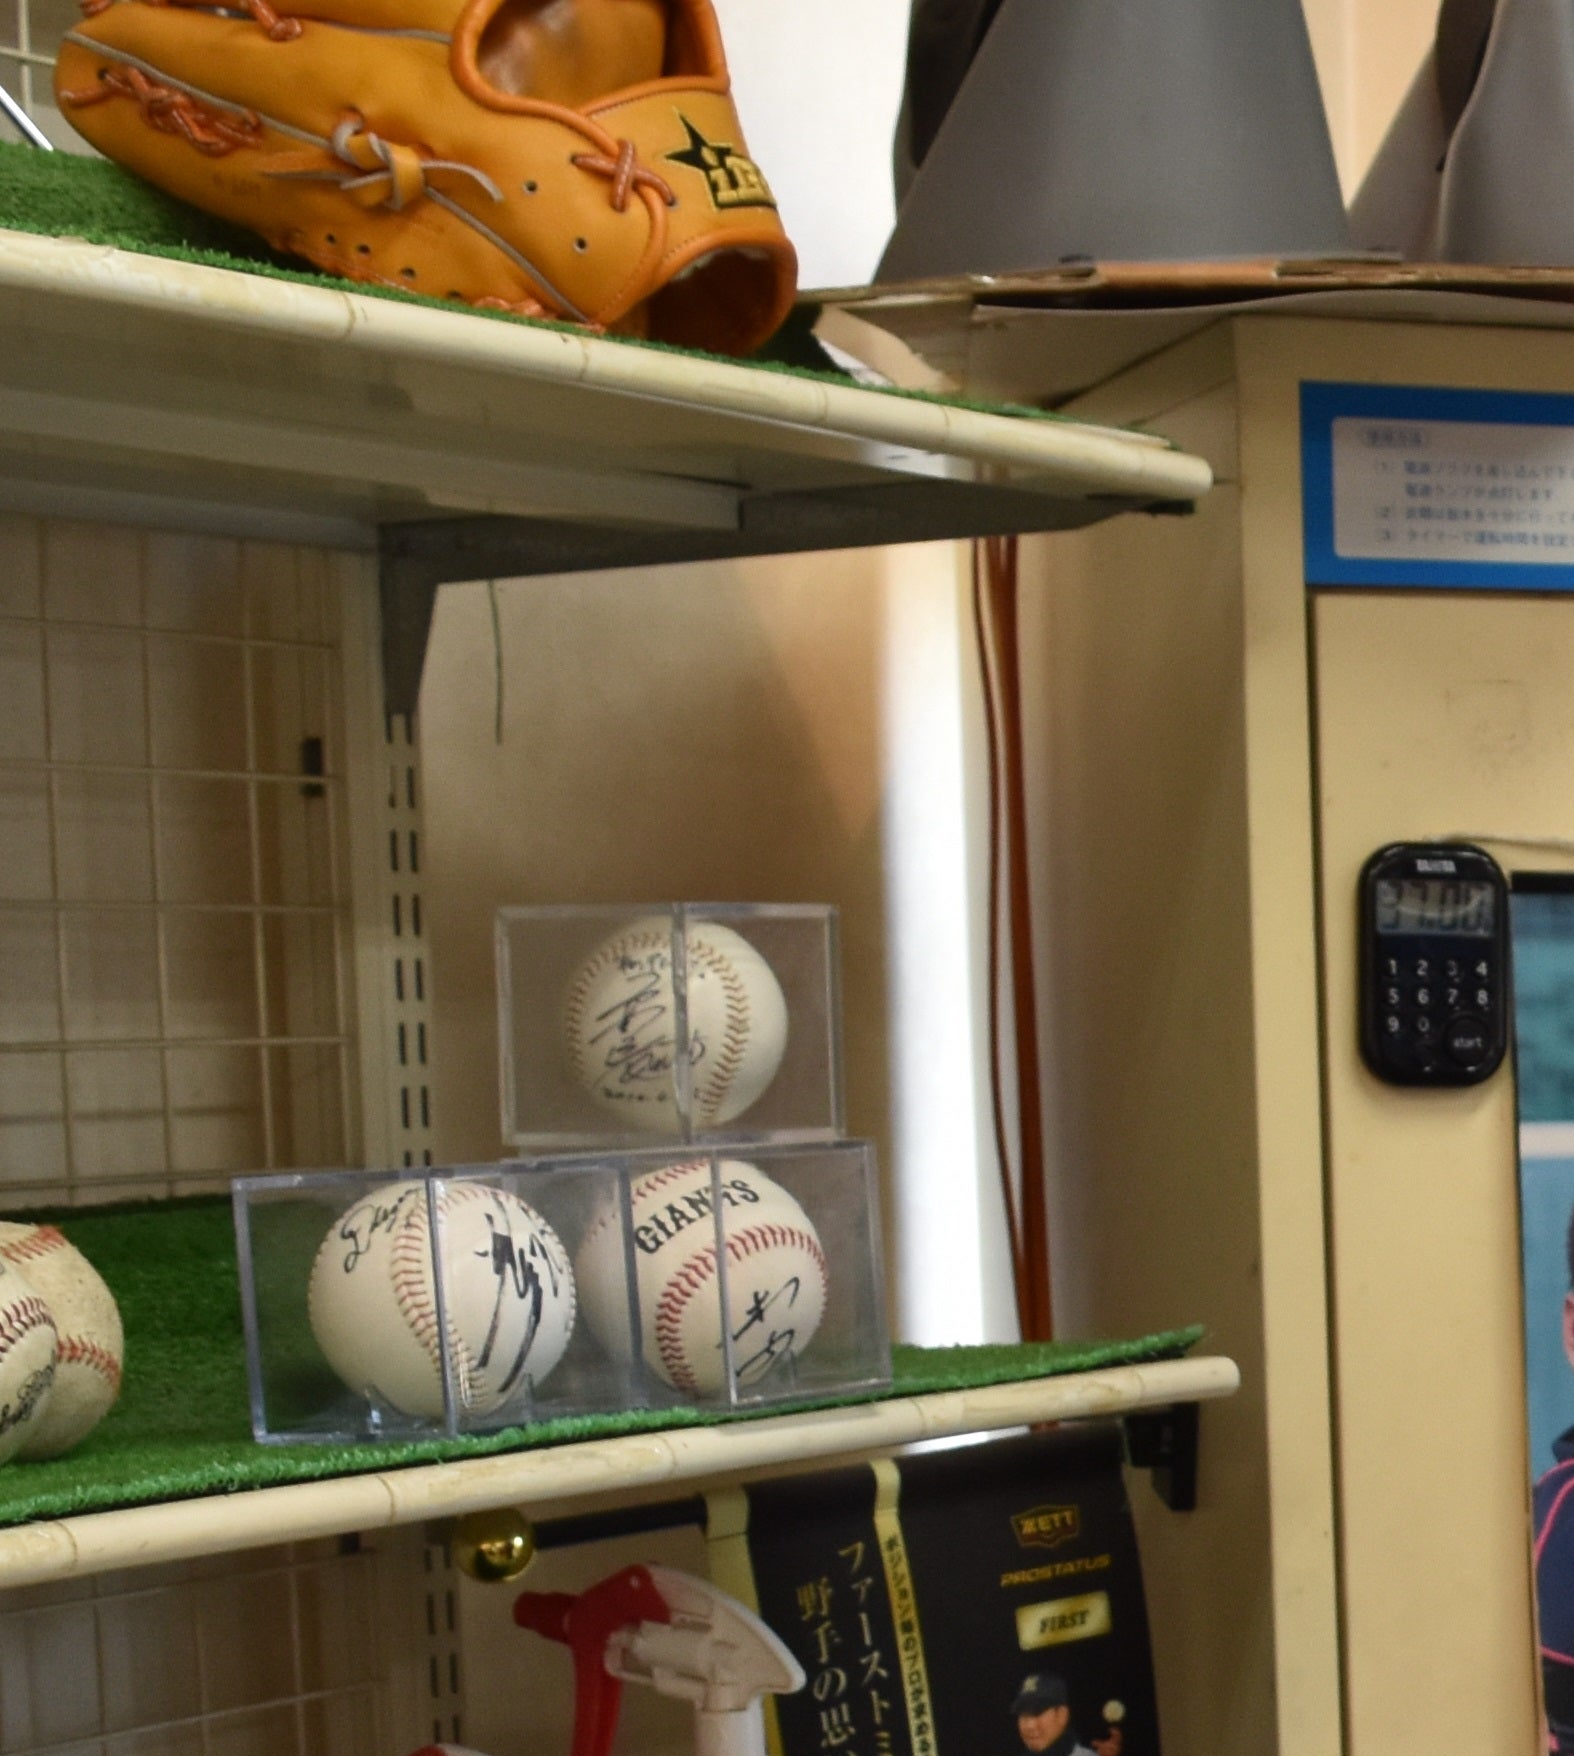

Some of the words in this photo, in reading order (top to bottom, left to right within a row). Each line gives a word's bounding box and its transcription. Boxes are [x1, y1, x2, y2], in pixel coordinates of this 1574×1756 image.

[1388, 959, 1398, 975] 1
[1416, 960, 1428, 976] 2
[1475, 960, 1488, 976] 4
[1388, 988, 1399, 1004] 5
[1418, 988, 1429, 1004] 6
[1448, 988, 1459, 1004] 7
[1476, 989, 1488, 1005] 8
[1387, 1016, 1400, 1033] 9
[633, 1178, 761, 1256] GIANTS
[1020, 1510, 1074, 1534] ZETT
[1000, 1553, 1111, 1588] PROSTATUS
[1038, 1608, 1090, 1634] FIRST
